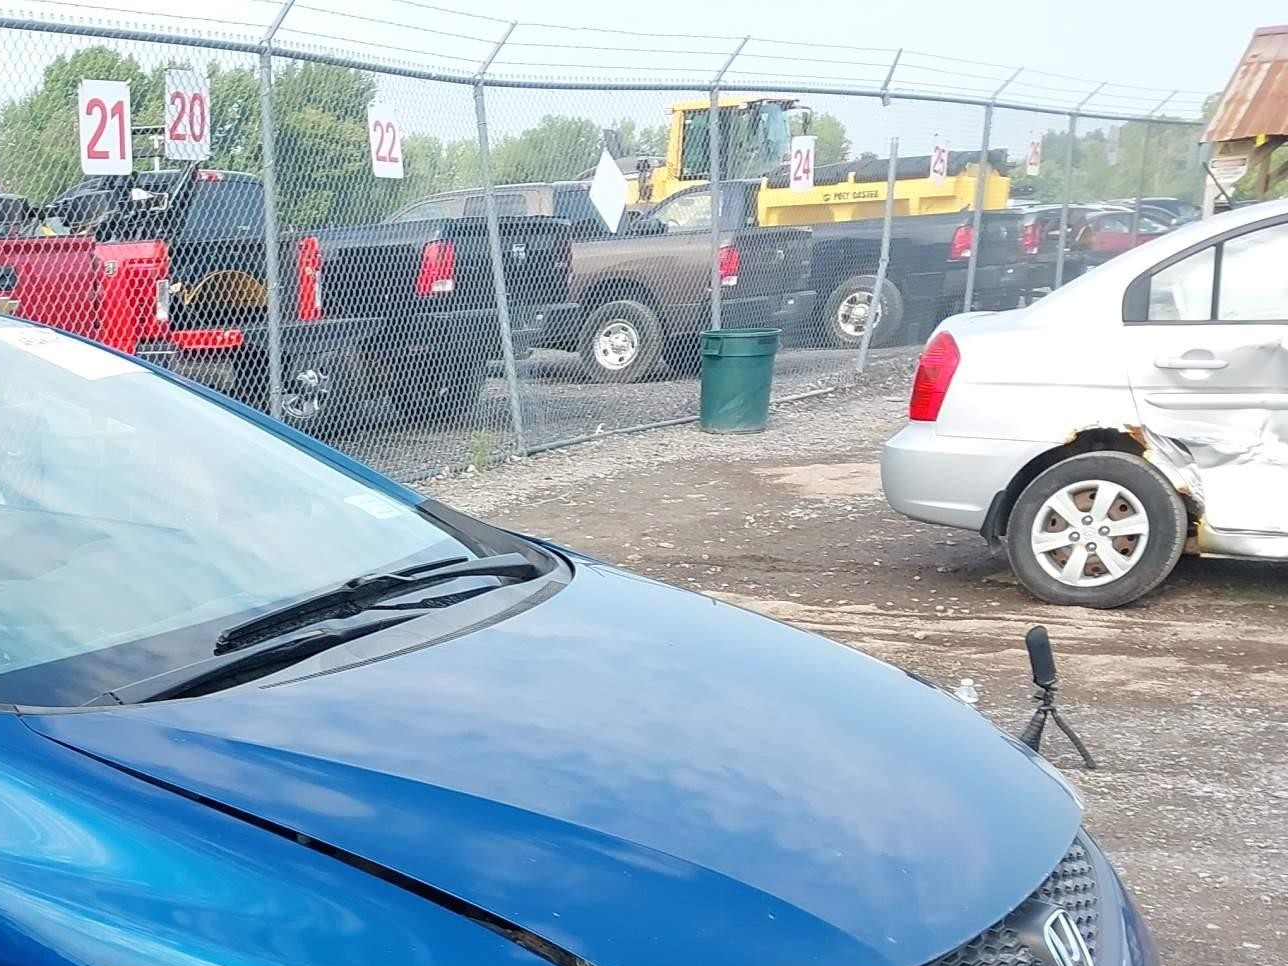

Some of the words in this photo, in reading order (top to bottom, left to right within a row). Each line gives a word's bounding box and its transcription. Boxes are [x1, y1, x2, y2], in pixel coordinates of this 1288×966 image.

[86, 98, 126, 160] 21
[169, 91, 206, 142] 20
[373, 120, 399, 163] 22
[793, 149, 810, 181] 24
